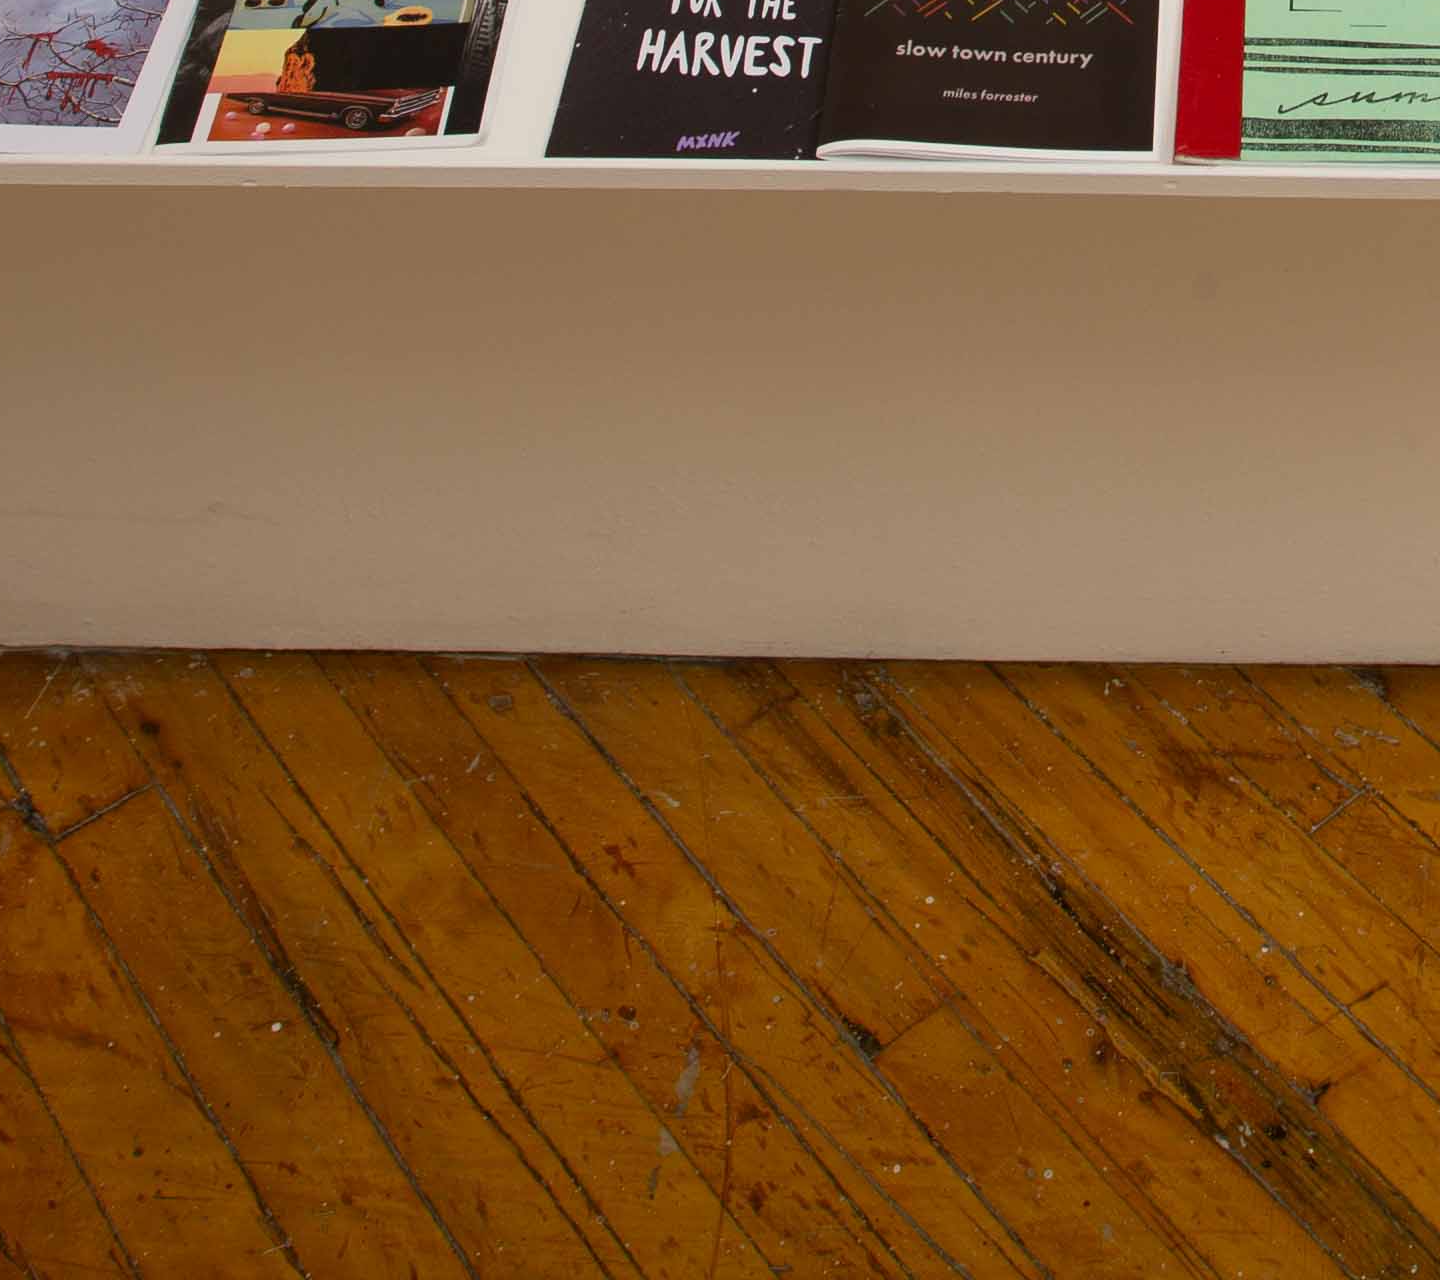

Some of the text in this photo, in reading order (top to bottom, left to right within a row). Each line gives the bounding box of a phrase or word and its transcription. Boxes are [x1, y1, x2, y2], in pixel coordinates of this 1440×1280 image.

[636, 27, 823, 79] HARVEST
[895, 39, 1095, 69] slow town century
[942, 87, 1040, 104] miles forrester
